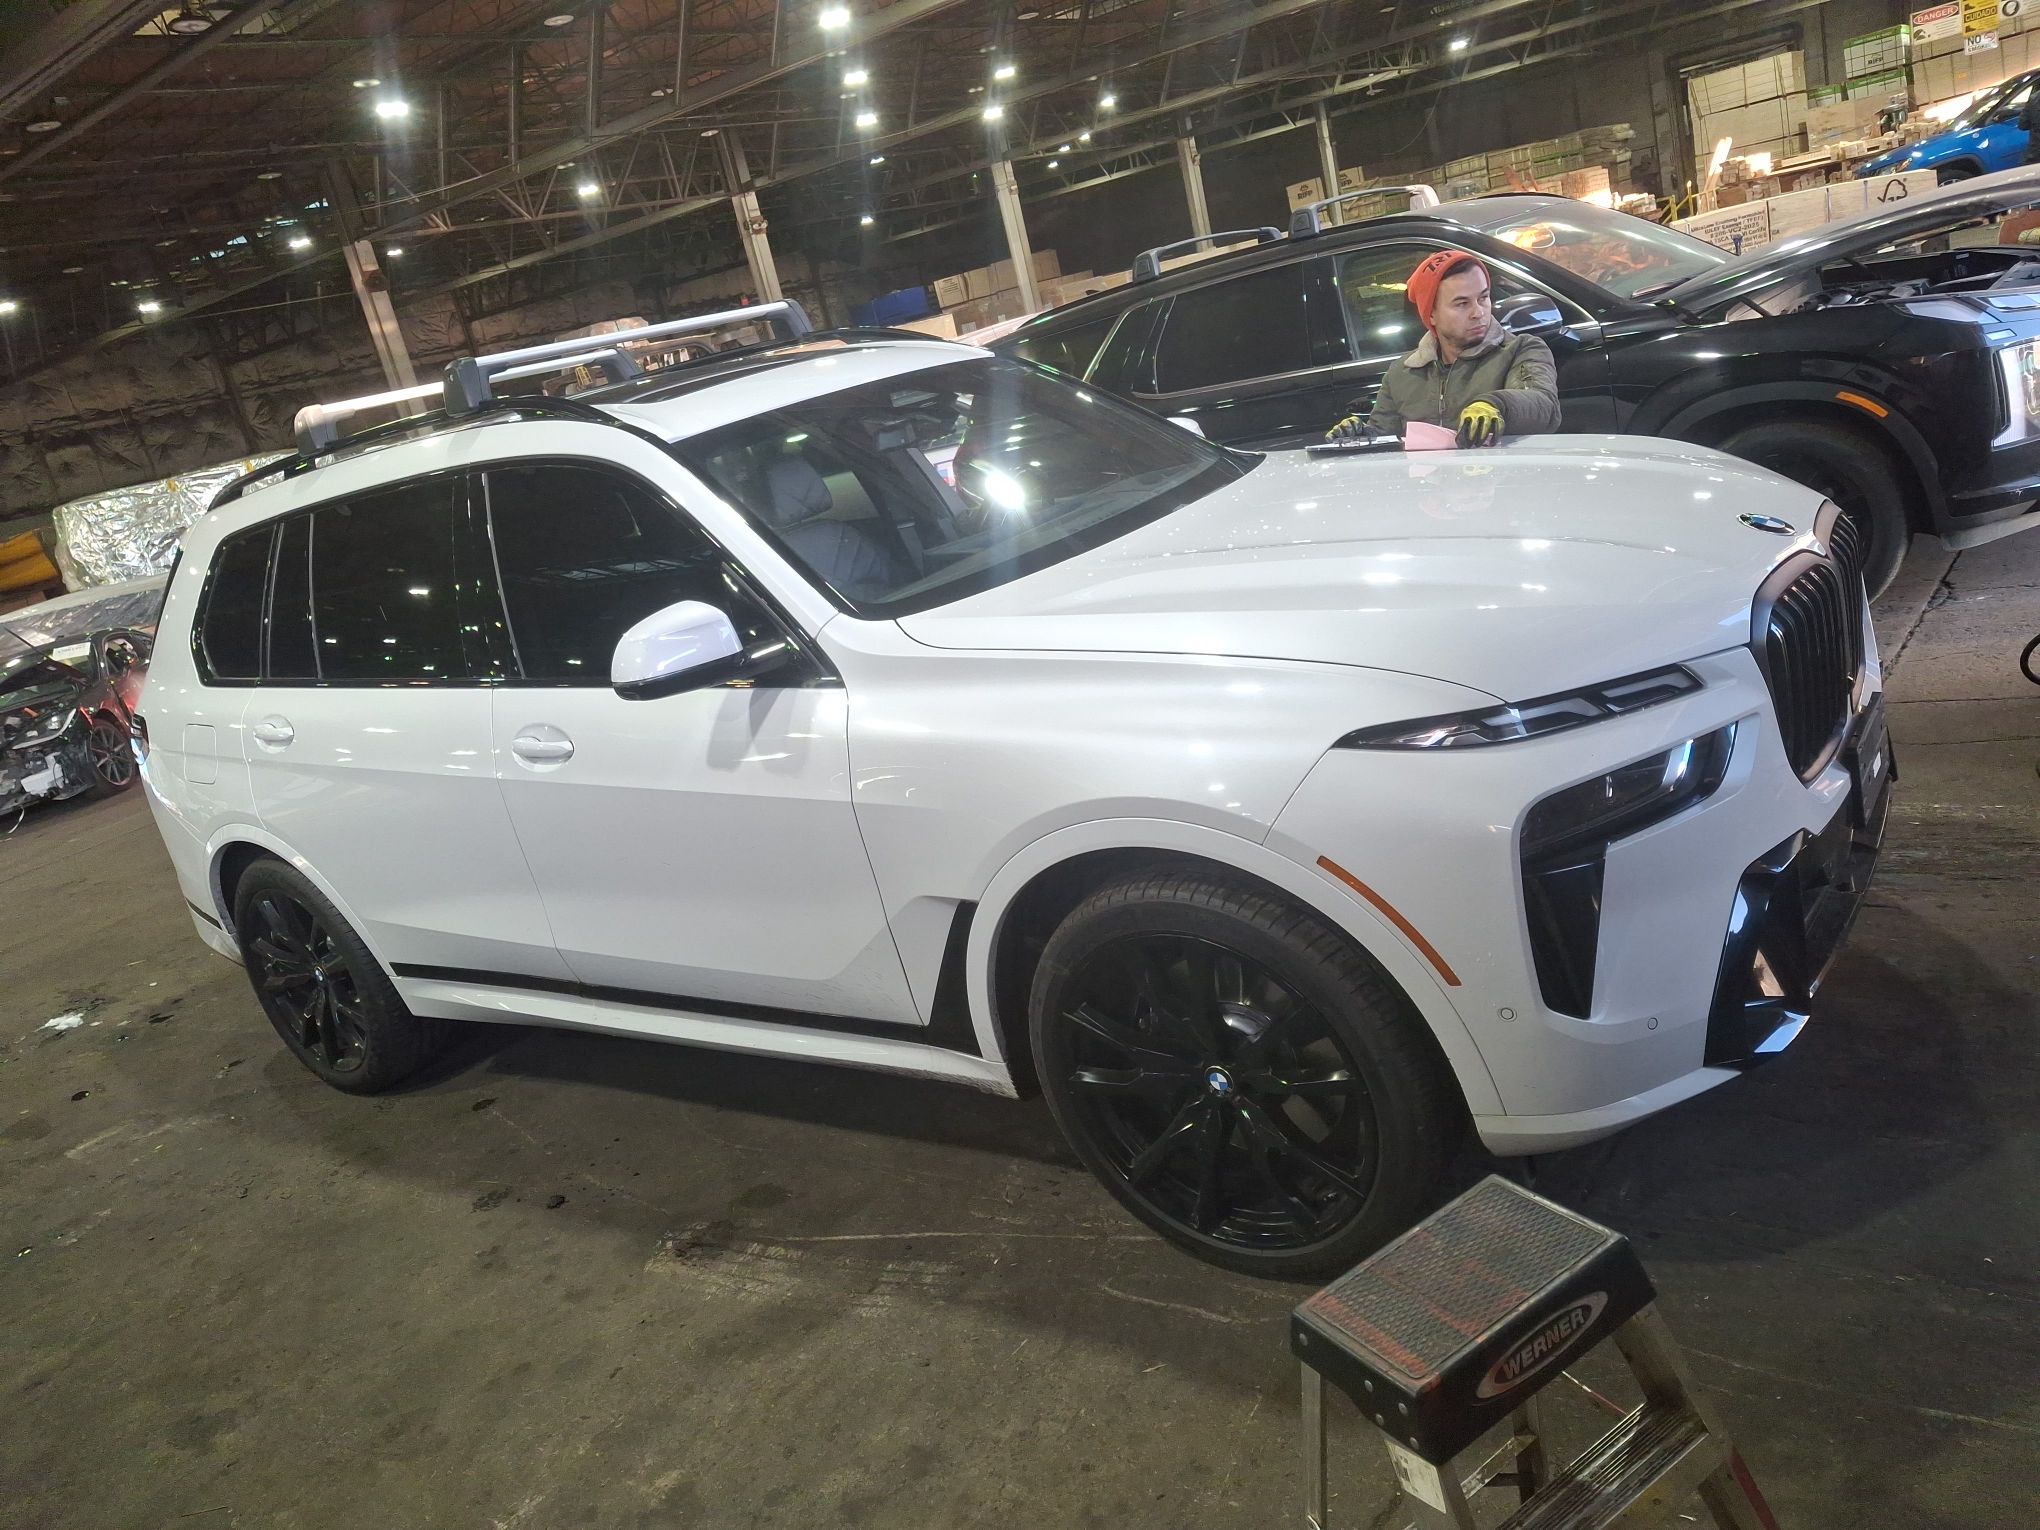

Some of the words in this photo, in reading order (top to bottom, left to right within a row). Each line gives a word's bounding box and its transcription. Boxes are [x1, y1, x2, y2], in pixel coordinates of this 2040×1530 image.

[1917, 8, 1954, 22] DANGER
[1965, 7, 1997, 22] CUIDADO
[1967, 35, 1982, 46] NO
[1502, 1308, 1585, 1380] WERNER
